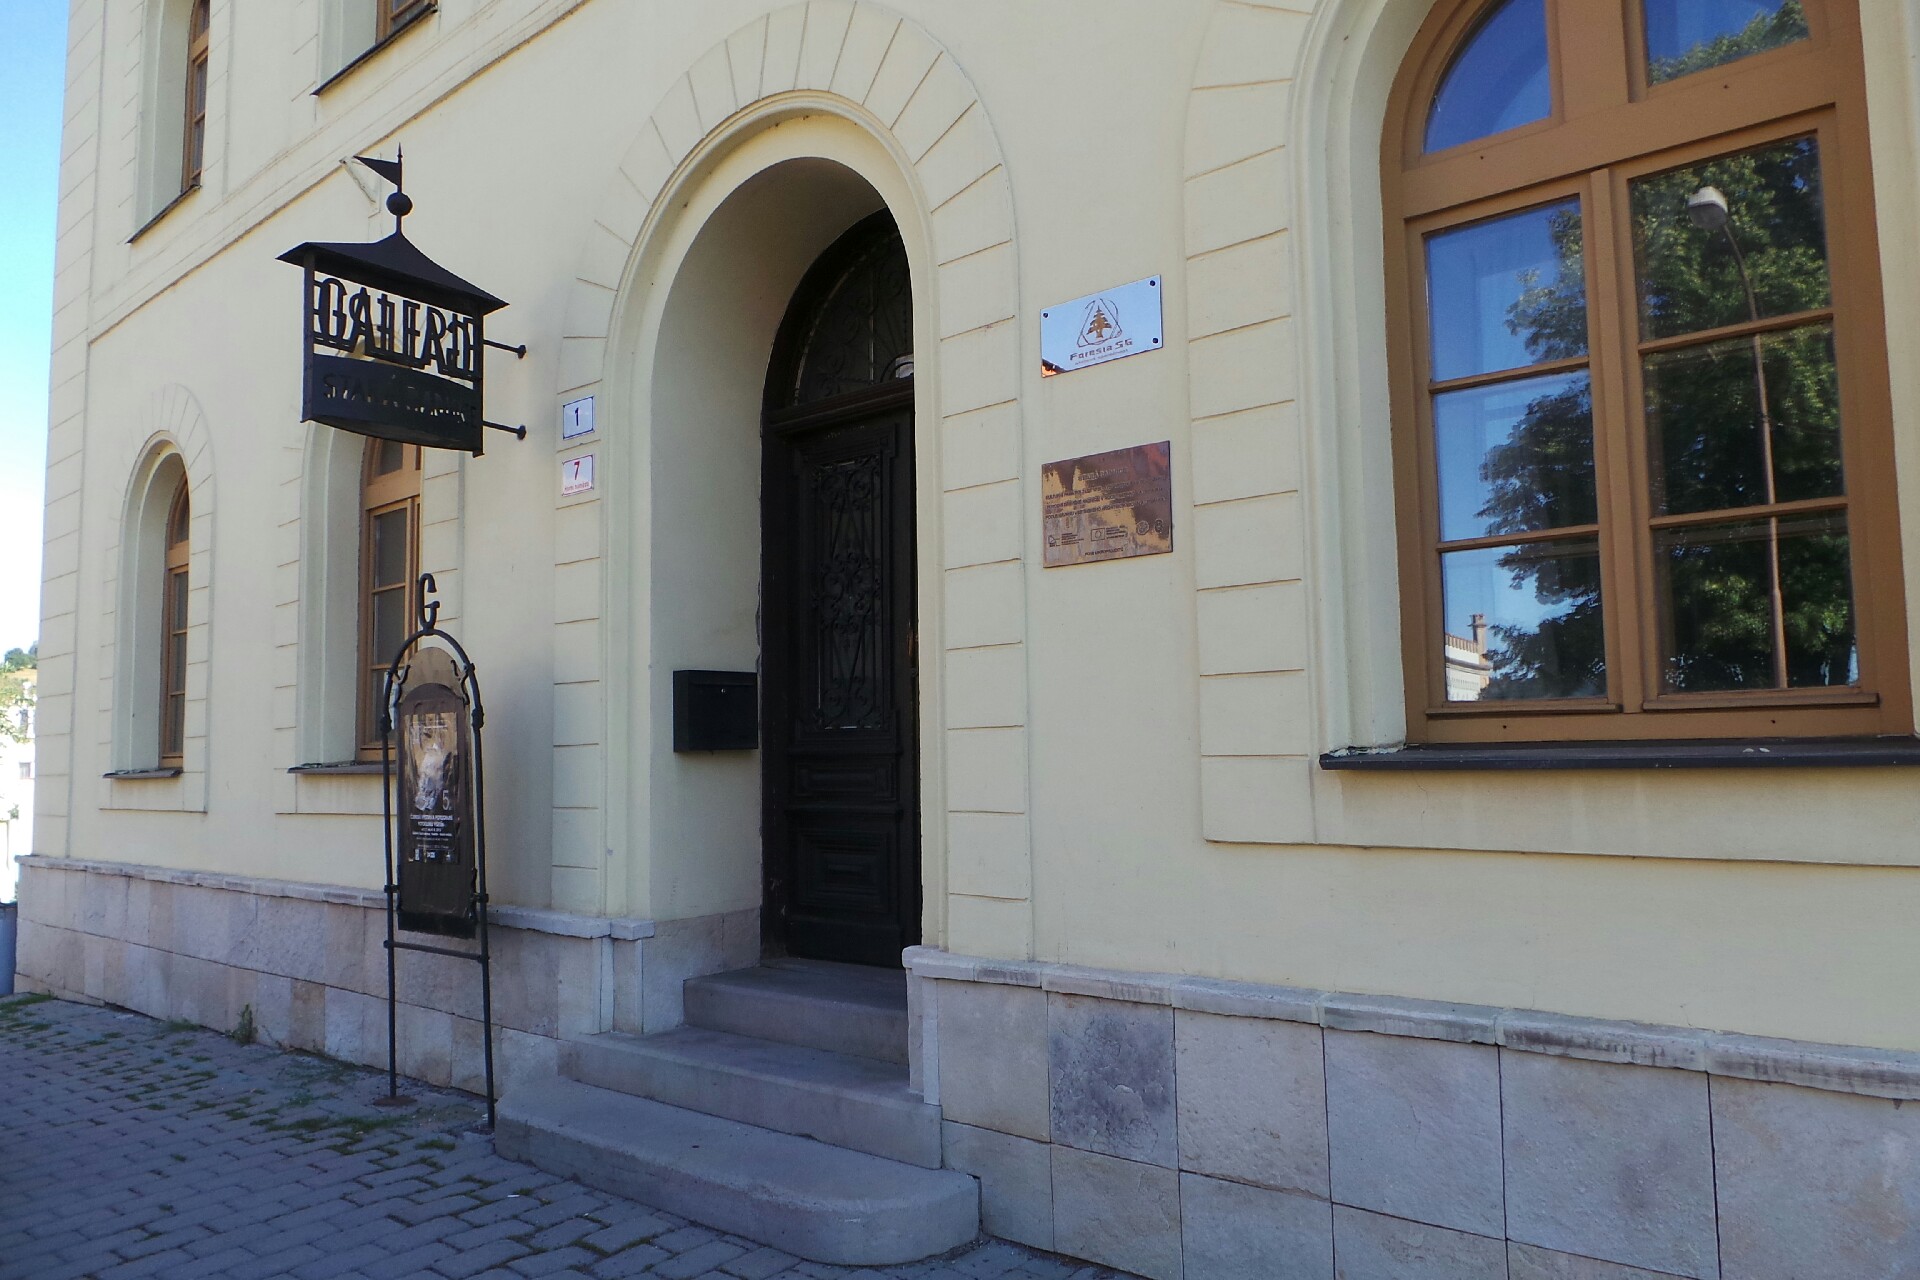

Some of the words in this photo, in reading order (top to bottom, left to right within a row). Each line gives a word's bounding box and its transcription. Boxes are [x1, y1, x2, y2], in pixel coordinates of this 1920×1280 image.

[1115, 338, 1133, 350] SG
[574, 407, 580, 427] 1
[573, 461, 581, 481] 7
